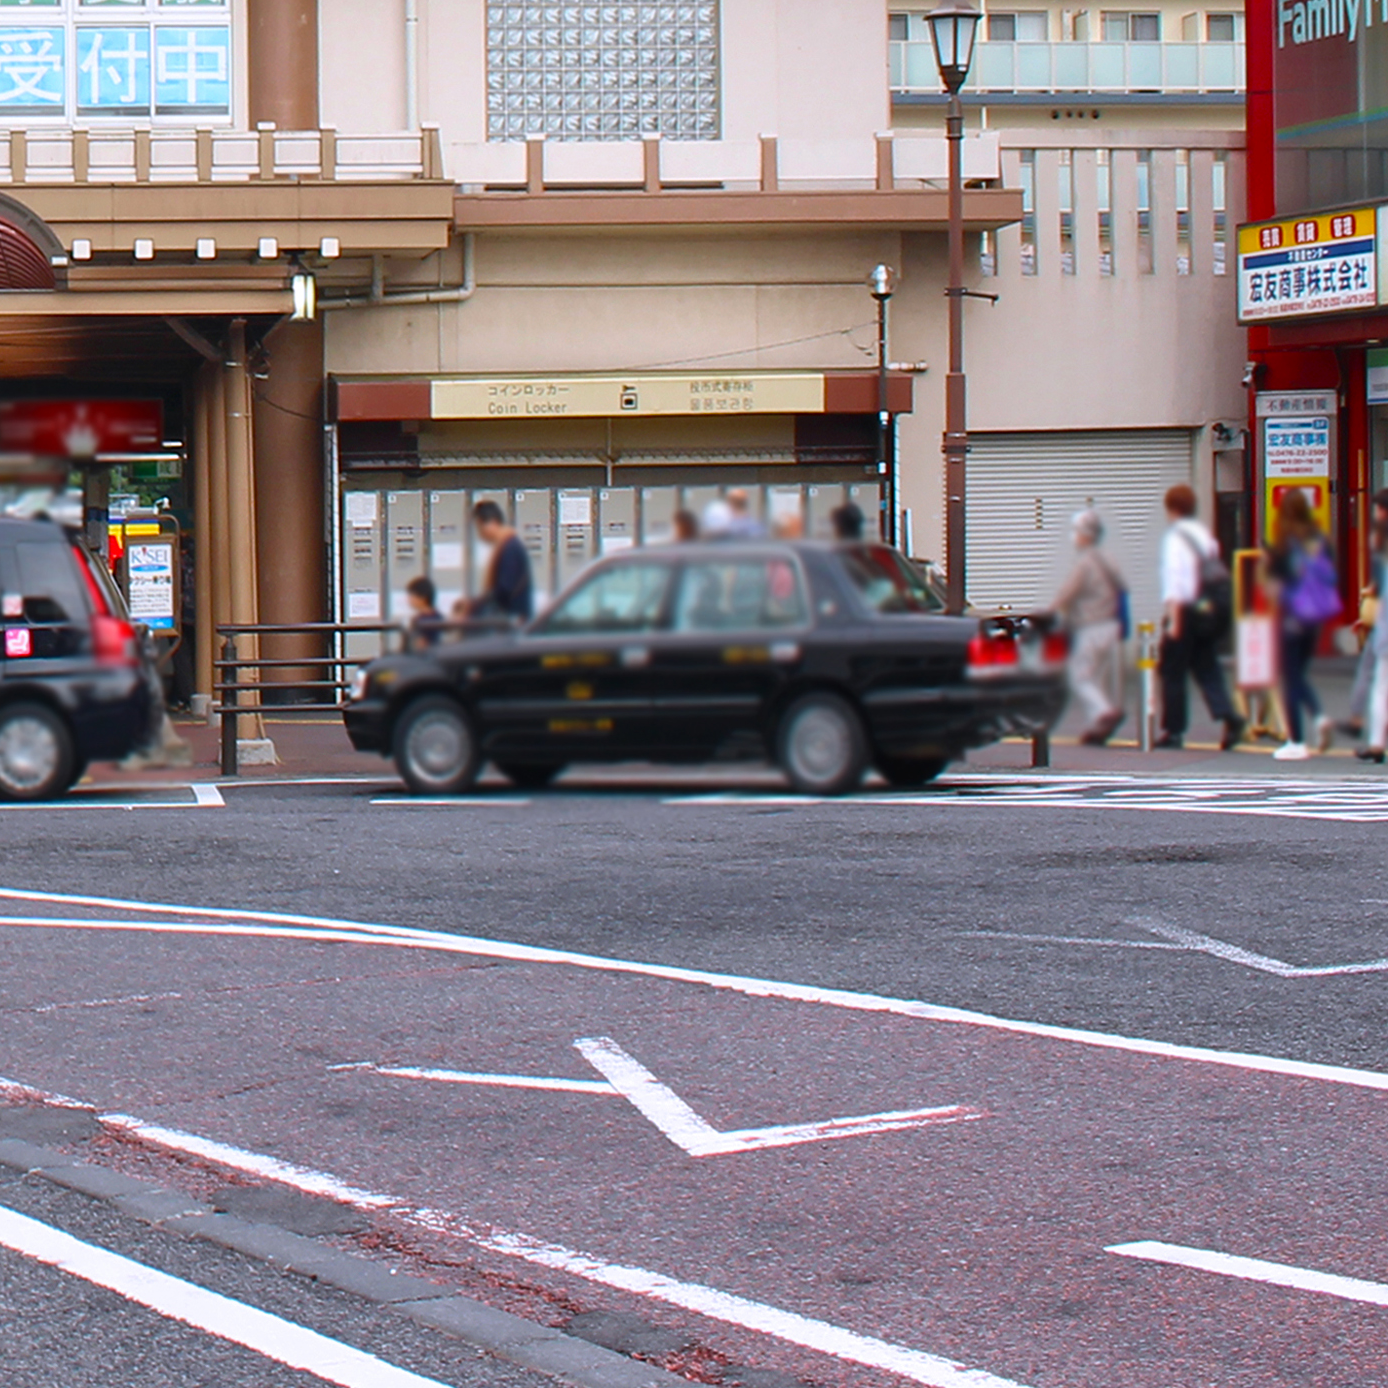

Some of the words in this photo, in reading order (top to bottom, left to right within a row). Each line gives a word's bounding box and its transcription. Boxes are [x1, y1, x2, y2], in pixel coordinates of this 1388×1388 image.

[1333, 215, 1353, 238] 管理
[1249, 257, 1368, 303] 宏友商事株式会社
[486, 384, 571, 396] コインロッカー
[488, 400, 519, 414] Coin
[525, 399, 567, 413] Locker
